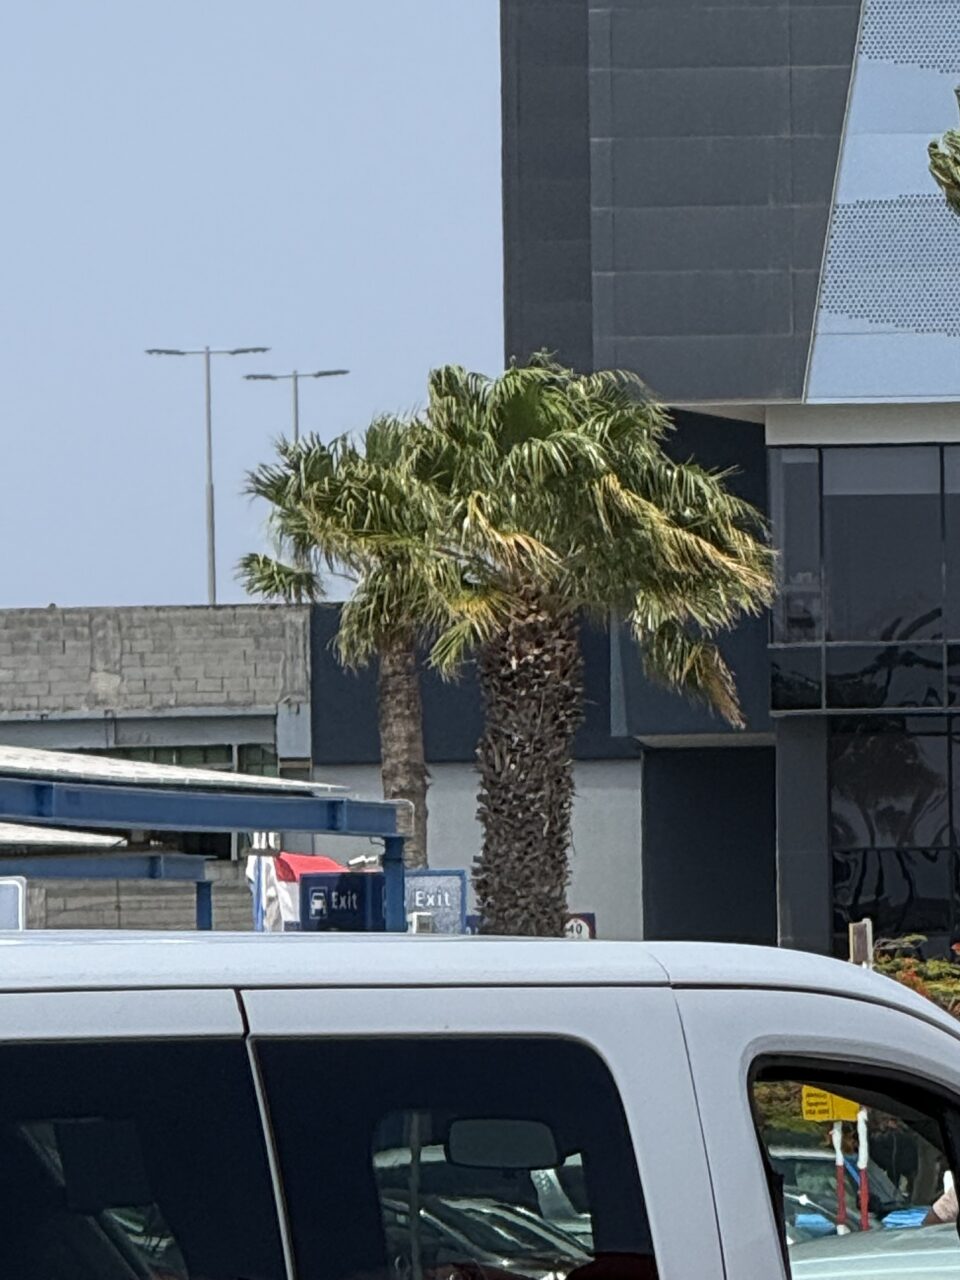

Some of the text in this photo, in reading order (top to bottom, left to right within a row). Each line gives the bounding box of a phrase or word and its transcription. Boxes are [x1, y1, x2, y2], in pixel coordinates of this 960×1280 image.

[331, 891, 358, 910] Exit
[415, 888, 451, 907] Exit
[567, 923, 583, 935] 40
